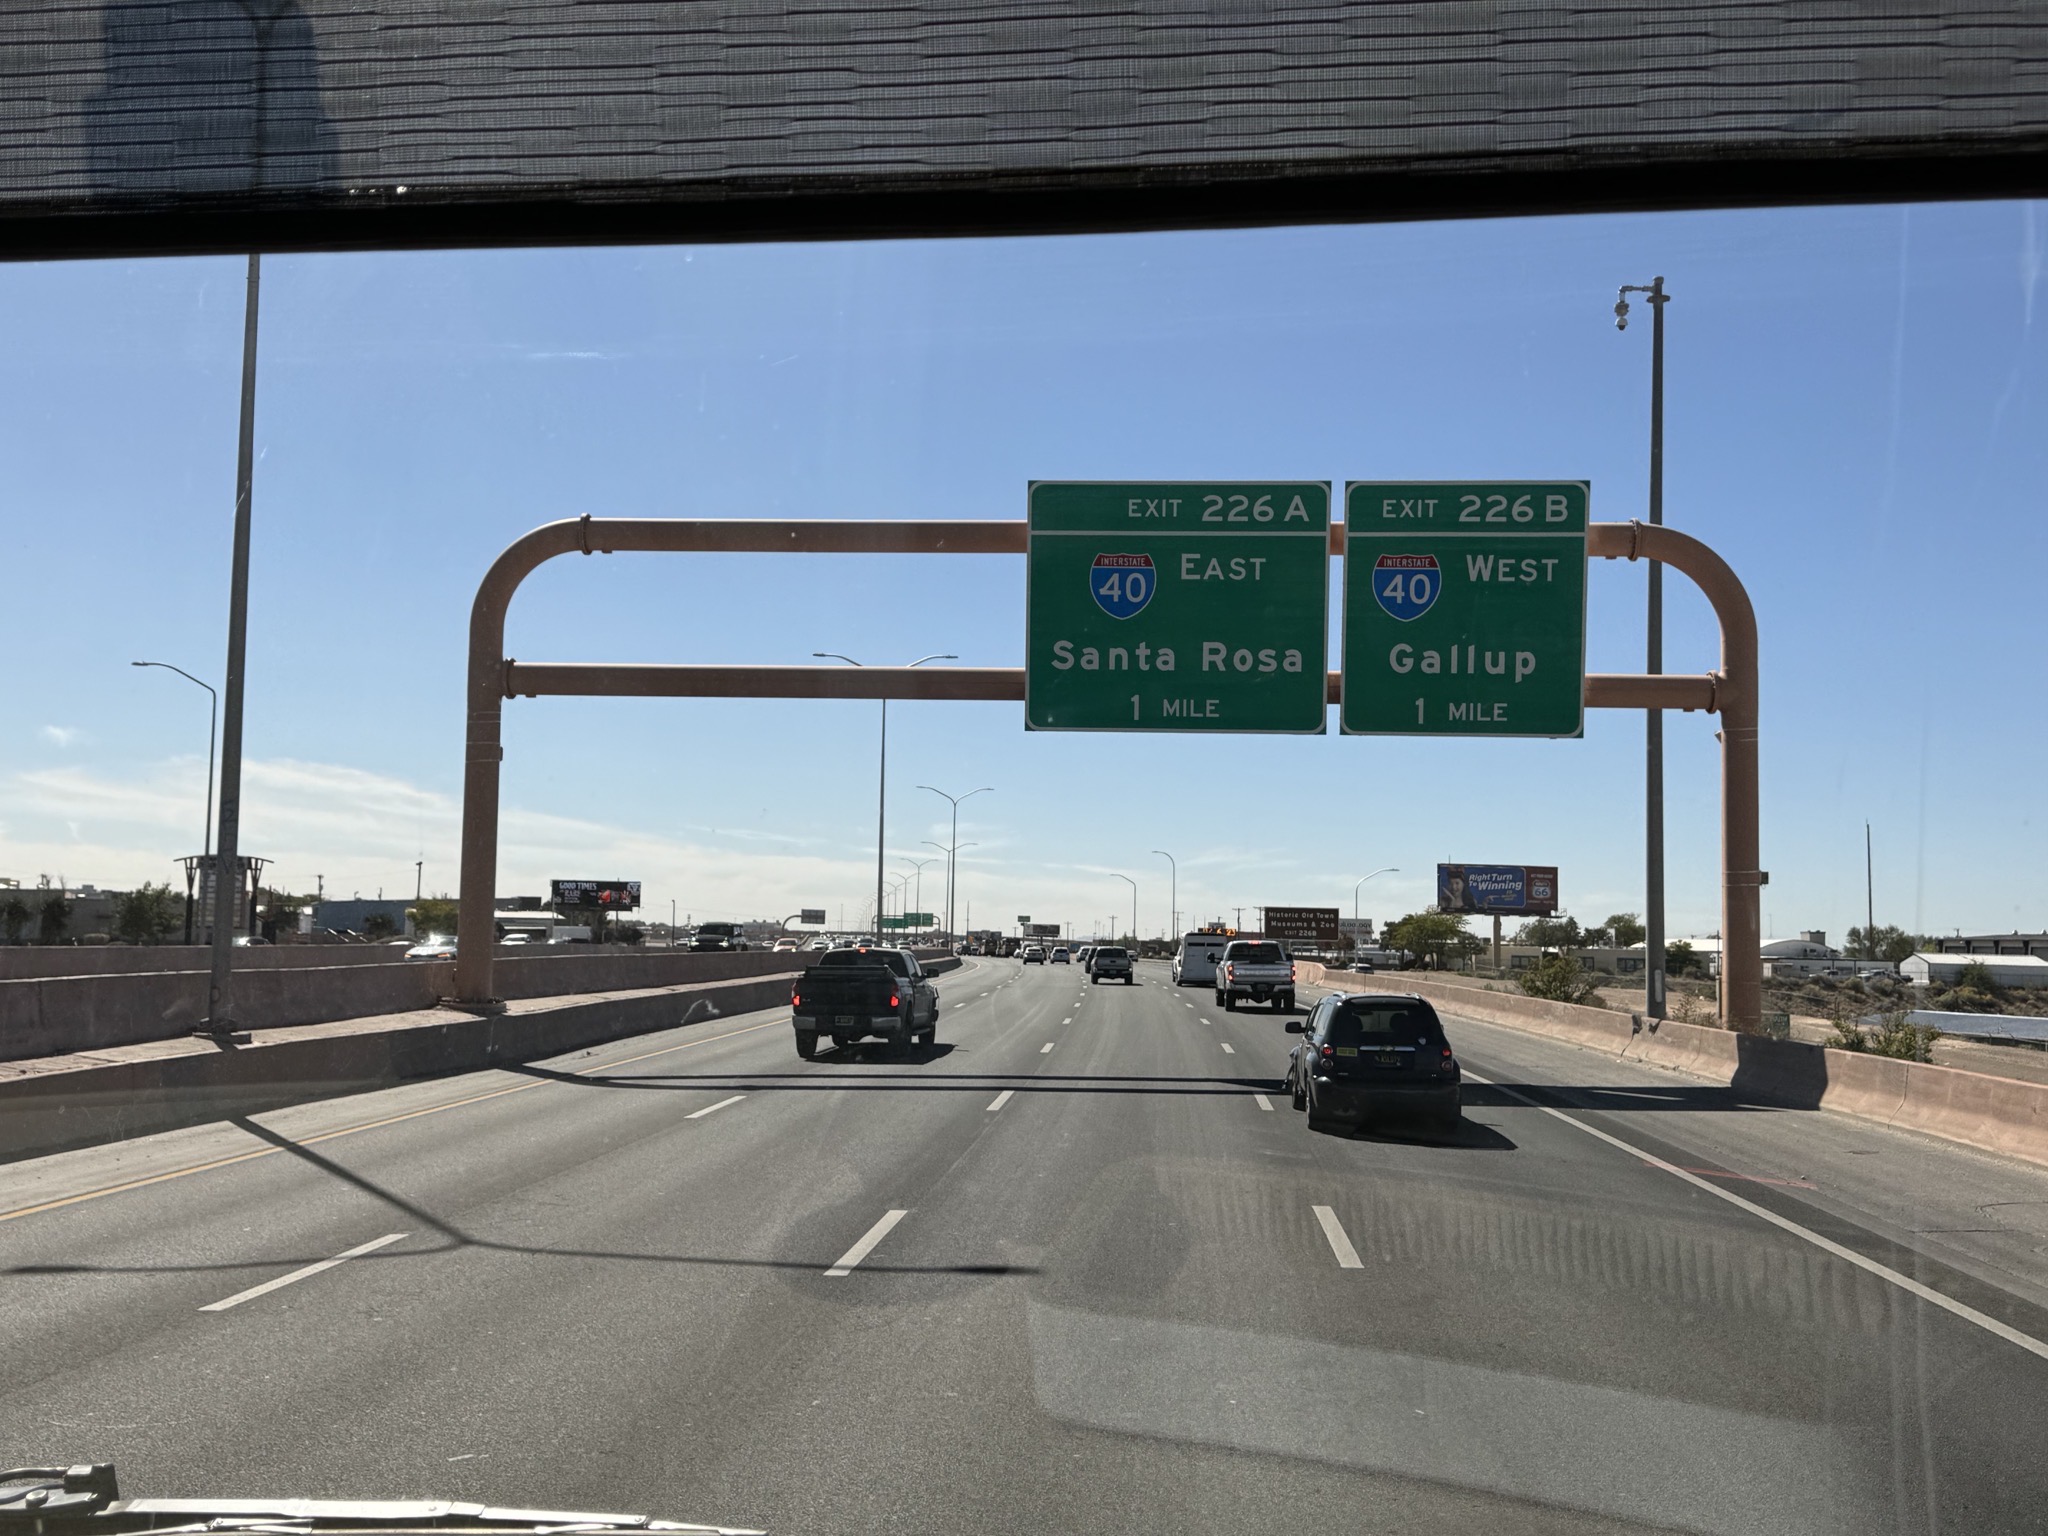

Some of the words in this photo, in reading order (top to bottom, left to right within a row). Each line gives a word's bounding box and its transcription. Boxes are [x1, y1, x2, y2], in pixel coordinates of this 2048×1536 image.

[1128, 499, 1183, 518] EXIT
[1201, 494, 1275, 522] 226
[1283, 494, 1310, 522] A
[1382, 499, 1439, 518] EXIT
[1458, 494, 1534, 523] 226
[1545, 494, 1569, 523] B
[1100, 557, 1146, 566] INTERSTATE
[1180, 552, 1267, 582] EAST
[1383, 558, 1431, 567] INTERSTATE
[1465, 554, 1559, 585] WEST
[1098, 572, 1147, 603] 40
[1382, 573, 1431, 605] 40
[1051, 639, 1176, 672] Santa
[1202, 641, 1303, 673] Rosa
[1389, 642, 1536, 684] Gallup
[1130, 694, 1140, 721] 1
[1162, 698, 1220, 718] MILE
[1415, 697, 1425, 725] 1
[1448, 702, 1508, 722] MILE
[1478, 881, 1523, 891] Winning
[1534, 888, 1549, 897] 66
[1268, 911, 1299, 919] Historic
[1270, 920, 1307, 928] Museums
